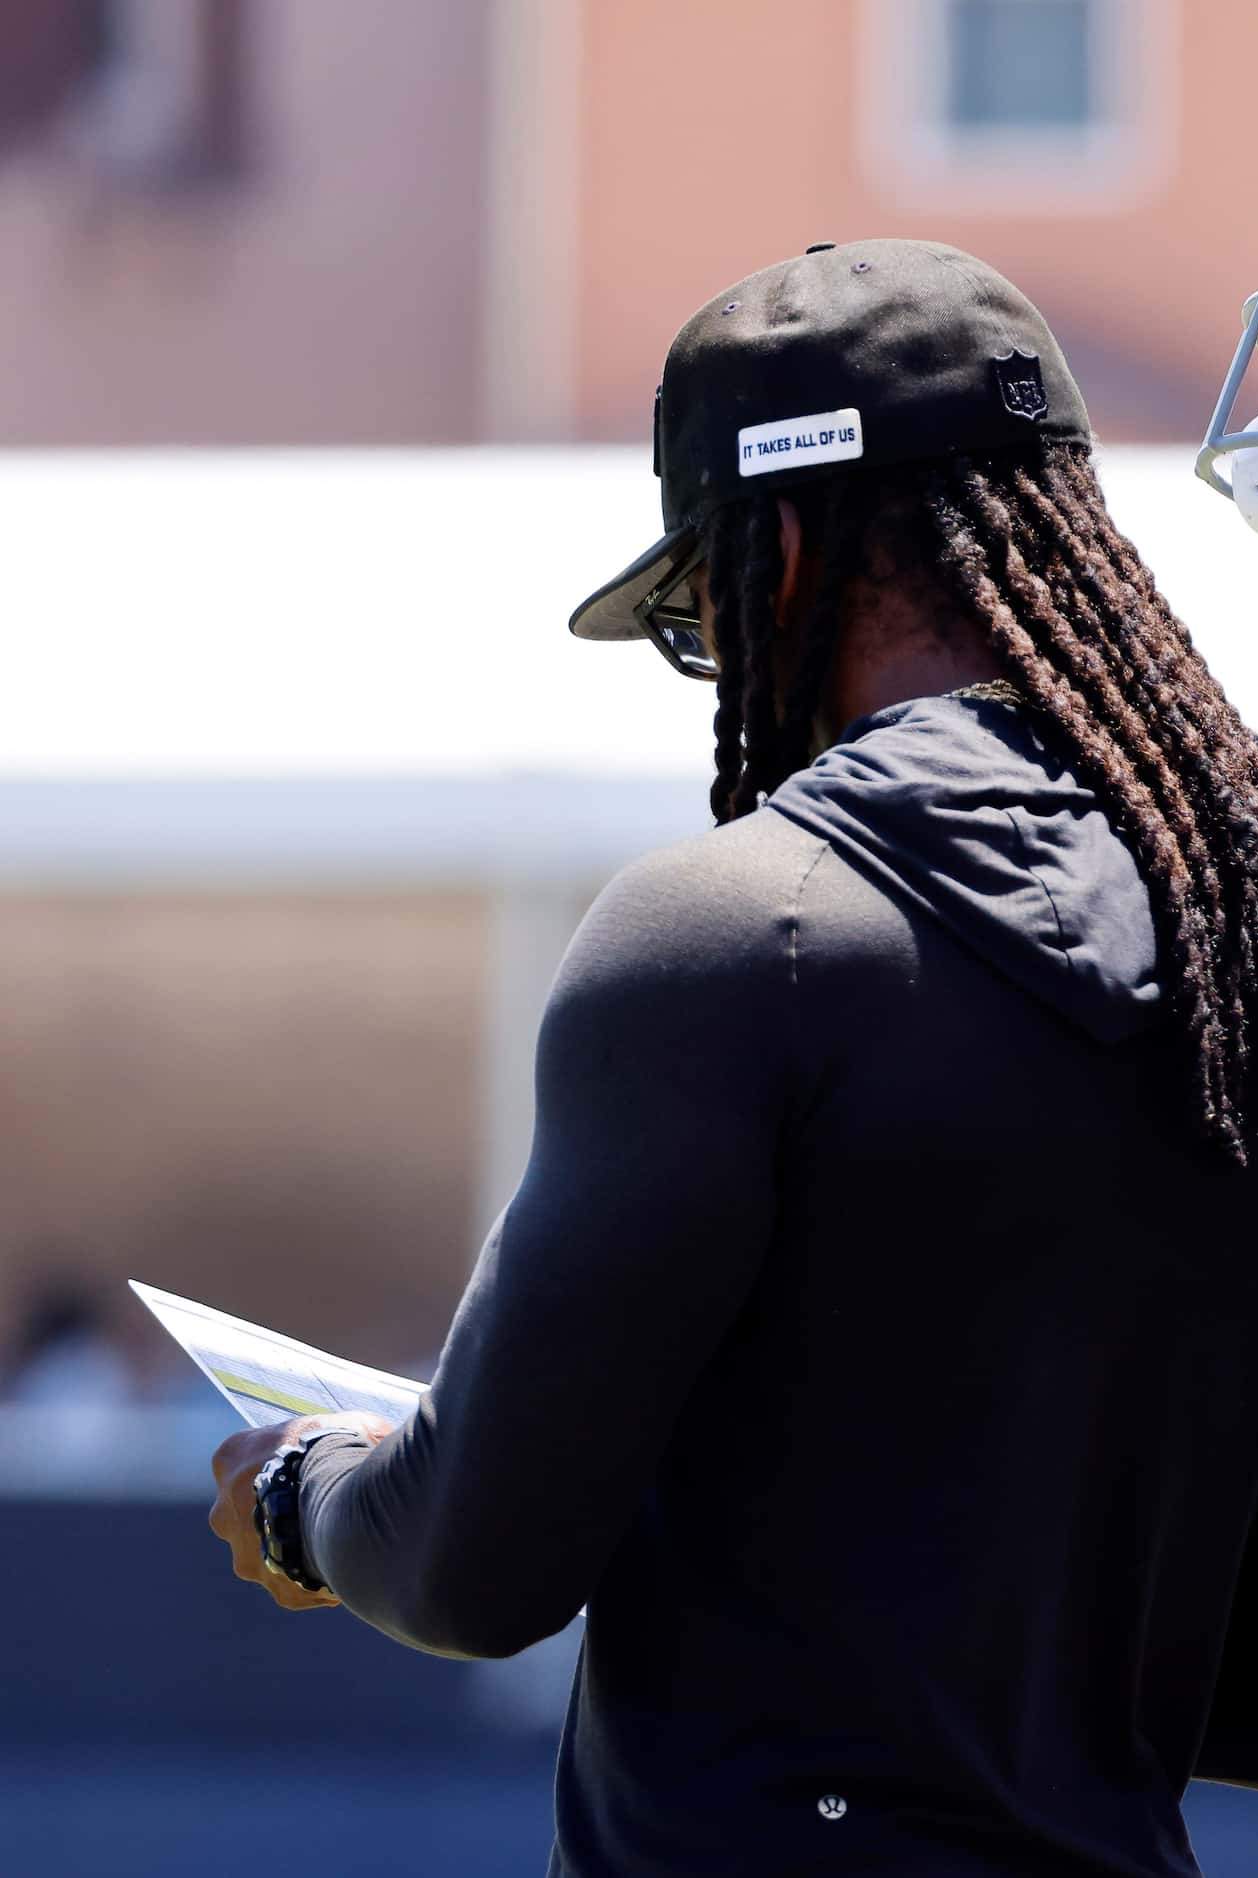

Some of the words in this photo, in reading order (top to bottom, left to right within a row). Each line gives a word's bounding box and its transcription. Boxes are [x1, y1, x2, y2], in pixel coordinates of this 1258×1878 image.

[743, 445, 753, 459] IT
[757, 437, 792, 456] TAKES
[795, 433, 817, 449] ALL
[819, 430, 835, 446] OF
[839, 427, 855, 442] US
